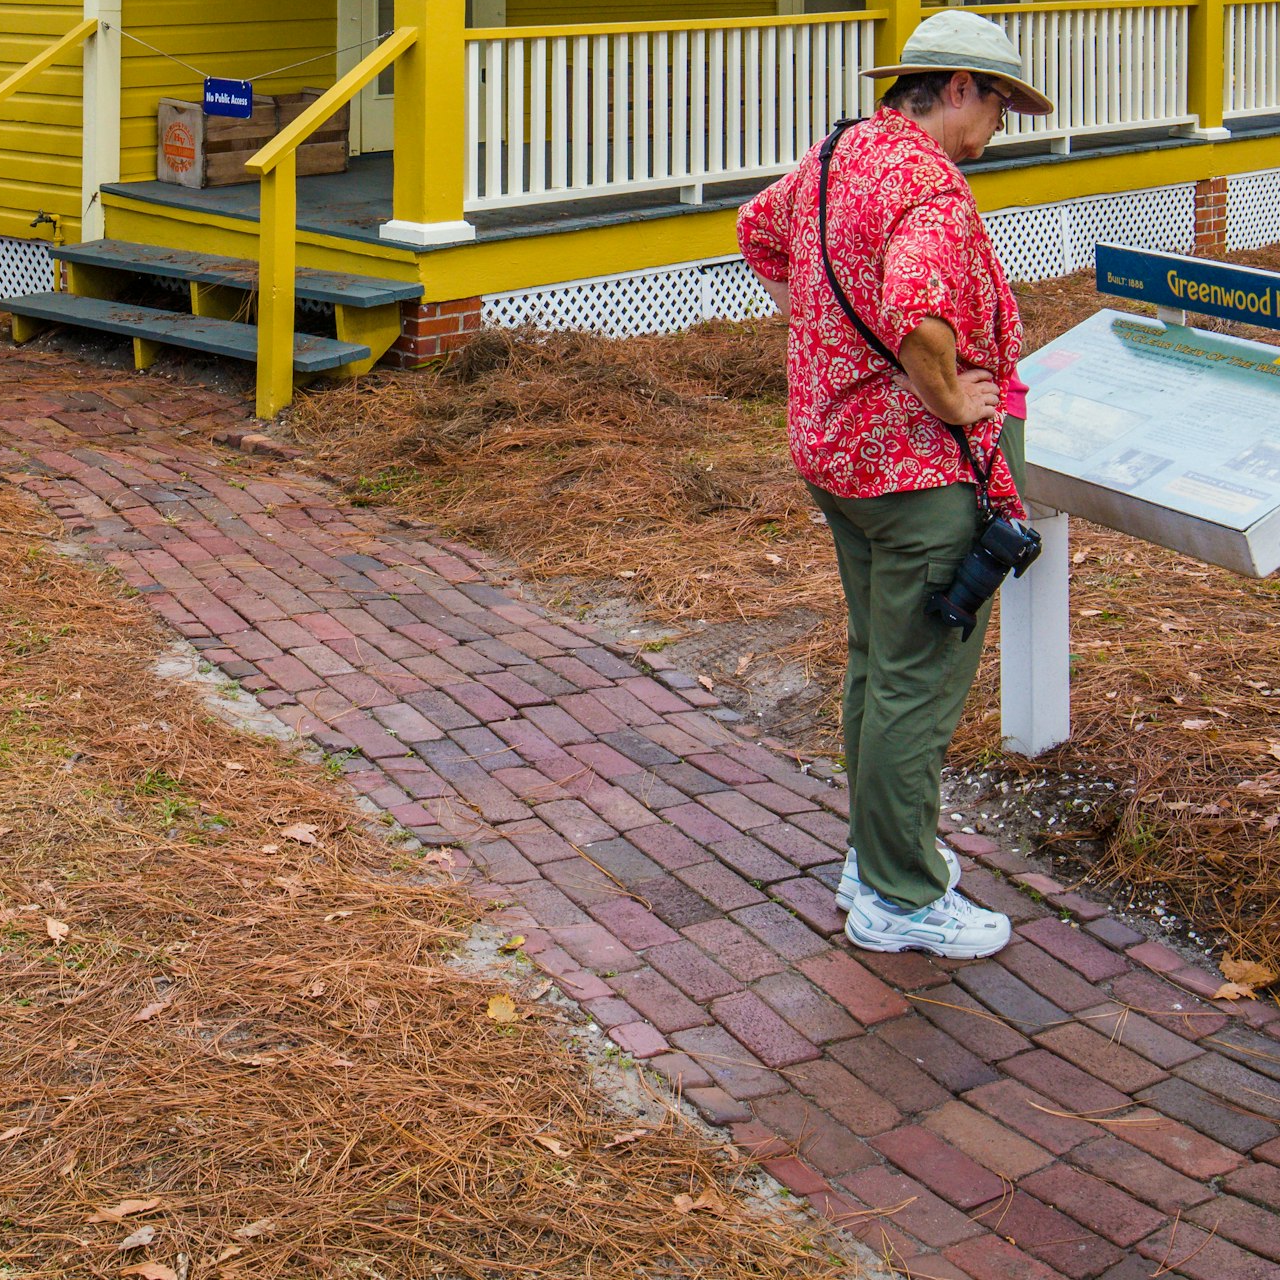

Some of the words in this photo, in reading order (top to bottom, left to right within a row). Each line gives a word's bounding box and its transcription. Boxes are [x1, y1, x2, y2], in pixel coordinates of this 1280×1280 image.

[206, 91, 215, 103] No
[215, 92, 231, 104] Public
[231, 94, 248, 106] Access
[1128, 278, 1144, 290] 1888
[1166, 269, 1271, 316] Greenwood
[1132, 333, 1174, 350] CLEAR
[1173, 342, 1208, 358] VIEW
[1205, 351, 1229, 362] OF
[1226, 355, 1256, 370] THE
